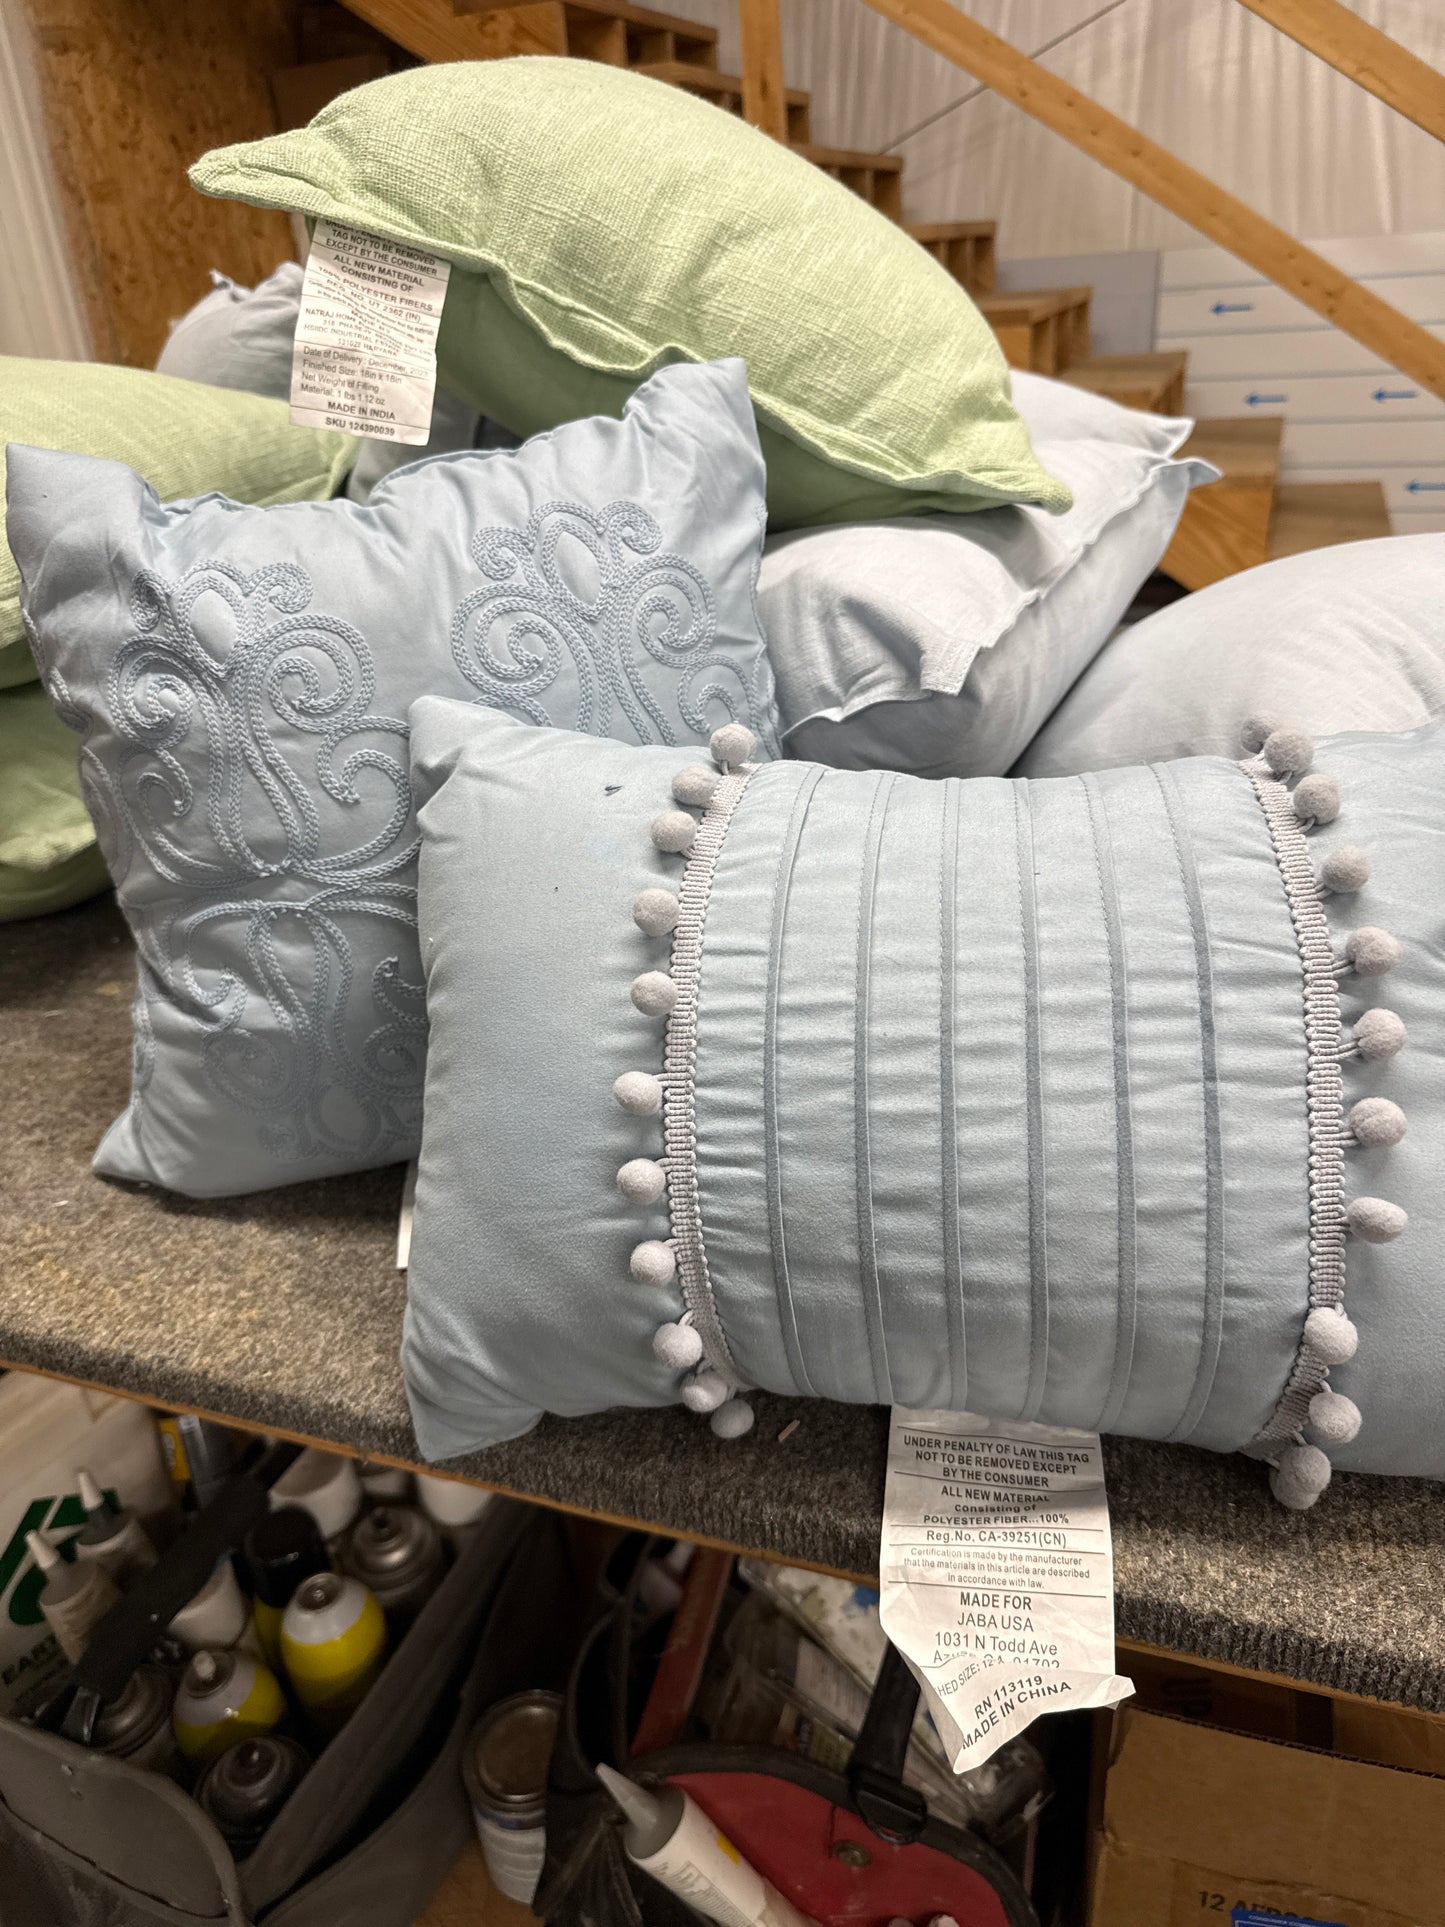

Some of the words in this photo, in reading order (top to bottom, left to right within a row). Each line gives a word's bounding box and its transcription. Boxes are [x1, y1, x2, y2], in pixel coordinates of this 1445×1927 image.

[326, 238, 358, 254] EXCEPT
[360, 248, 371, 258] BY
[374, 250, 388, 262] THE
[391, 255, 438, 276] CONSUMER
[332, 229, 348, 240] TAG
[350, 234, 368, 246] NOT
[369, 238, 380, 249] TO
[382, 242, 393, 253] BE
[396, 246, 436, 266] REMOVED
[334, 254, 352, 266] ALL
[354, 260, 376, 272] NEW
[379, 264, 424, 286] MATERIAL
[341, 265, 398, 290] CONSISTING
[400, 283, 414, 292] OF
[343, 278, 396, 303] POLYESTER
[399, 296, 432, 312] FIBERS
[303, 346, 321, 356] Date
[323, 349, 332, 358] of
[302, 358, 336, 374] Finished
[360, 369, 377, 380] 18in
[386, 374, 402, 384] 18in
[302, 371, 316, 380] Net
[318, 374, 345, 388] Weight
[356, 381, 380, 394] Filling
[344, 391, 356, 400] lbs
[376, 398, 386, 406] oz
[328, 401, 356, 414] MADE
[358, 406, 368, 416] IN
[370, 409, 396, 420] INDIA
[325, 417, 346, 428] SKU
[348, 422, 395, 436] 124390039
[904, 1434, 942, 1449] UNDER
[944, 1439, 993, 1454] PENALTY
[995, 1443, 1010, 1454] OF
[1013, 1445, 1037, 1459] LAW
[1038, 1450, 1064, 1462] THIS
[1066, 1452, 1090, 1464] TAG
[915, 1450, 938, 1462] NOT
[940, 1452, 955, 1464] TO
[957, 1454, 972, 1466] BE
[974, 1456, 1030, 1470] REMOVED
[1032, 1462, 1077, 1475] EXCEPT
[942, 1466, 957, 1478] BY
[960, 1468, 982, 1481] THE
[984, 1471, 1049, 1488] CONSUMER
[941, 1485, 962, 1498] ALL
[965, 1488, 990, 1501] NEW
[993, 1491, 1050, 1503] MATERIAL
[1023, 1504, 1037, 1512] of
[923, 1514, 991, 1526] POLYESTER
[978, 1531, 1067, 1549] CA-39251(CN)
[910, 1547, 962, 1559] Certification
[964, 1550, 970, 1559] is
[972, 1550, 996, 1560] made
[998, 1552, 1008, 1562] by
[1009, 1552, 1023, 1562] the
[1025, 1554, 1082, 1566] manufacturer
[904, 1558, 920, 1567] that
[922, 1558, 934, 1568] the
[937, 1560, 976, 1571] materials
[977, 1562, 985, 1571] in
[987, 1562, 1002, 1572] this
[1004, 1564, 1030, 1575] article
[1032, 1568, 1046, 1576] are
[1048, 1566, 1090, 1579] described
[958, 1575, 1007, 1586] accordance
[1008, 1577, 1026, 1588] with
[1028, 1578, 1045, 1589] law.
[960, 1591, 1000, 1609] MADE
[1004, 1595, 1032, 1611] FOR
[957, 1612, 998, 1629] JABA
[1001, 1616, 1034, 1632] USA
[935, 1632, 970, 1648] 1031
[975, 1634, 986, 1650] N
[990, 1636, 1026, 1654] Todd
[1029, 1640, 1058, 1656] Ave
[974, 1696, 992, 1719] RN
[993, 1675, 1043, 1701] 113119
[962, 1710, 1000, 1750] MADE
[1000, 1698, 1015, 1718] IN
[1017, 1681, 1072, 1704] CHINA
[1199, 1891, 1226, 1912] 12
